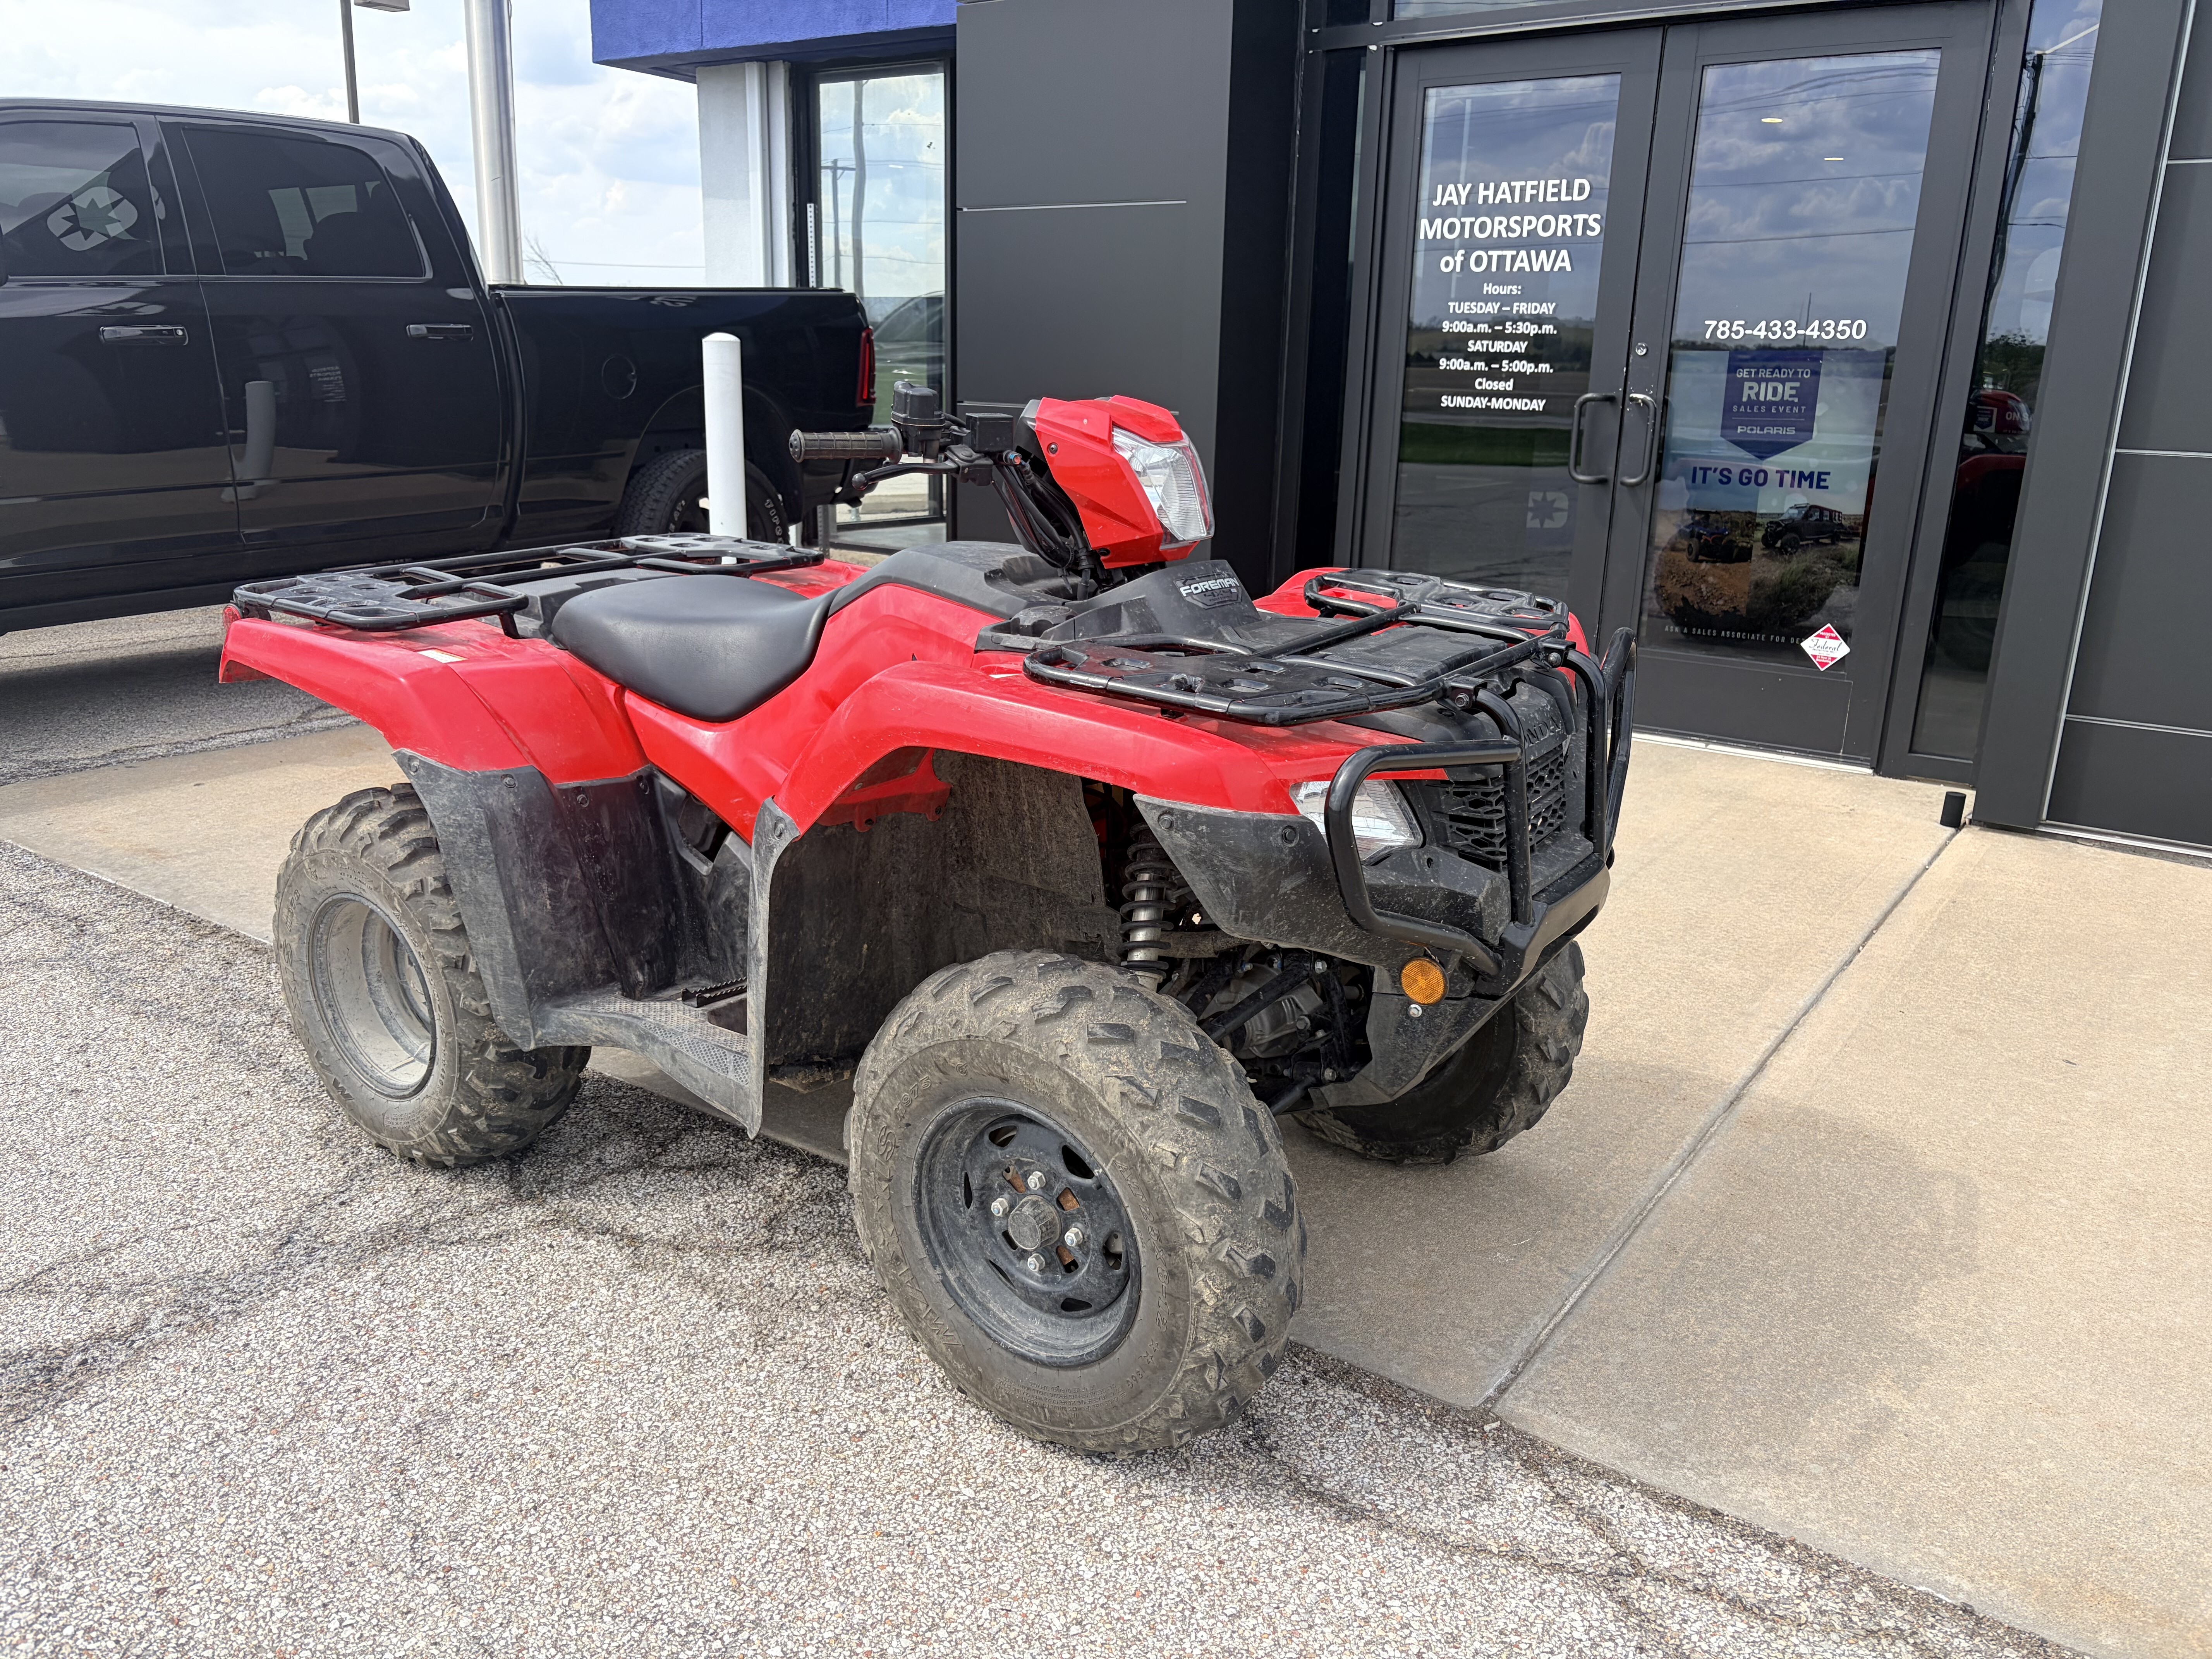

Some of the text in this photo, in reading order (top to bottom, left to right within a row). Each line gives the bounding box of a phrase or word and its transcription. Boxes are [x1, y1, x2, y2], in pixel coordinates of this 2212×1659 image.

[1432, 179, 1590, 206] JAY HATFIELD
[1419, 213, 1601, 240] MOTORSPORTS
[1440, 249, 1571, 273] of OTTAWA
[1483, 283, 1522, 295] Hours:
[1448, 302, 1501, 314] TUESDAY
[1513, 302, 1556, 314] FRIDAY
[1442, 320, 1492, 333] 9:00a.m.
[1504, 321, 1557, 337] 5:30p.m.
[1704, 319, 1867, 340] 785-433-4350
[1467, 340, 1528, 353] SATURDAY
[1439, 358, 1488, 371] 9:00a.m.
[1501, 360, 1553, 375] 5:00p.m.
[1736, 368, 1810, 378] GET READY TO
[1475, 378, 1514, 391] Closed
[1742, 381, 1800, 402] RIDE
[1441, 395, 1546, 411] SUNDAY-MONDAY
[1737, 426, 1796, 434] POLARIS
[1738, 468, 1768, 487] GO
[1776, 470, 1831, 489] TIME
[1180, 577, 1240, 597] FOREMAN
[1692, 628, 1716, 636] SALES
[1721, 630, 1765, 641] ASSOCIATE
[1808, 638, 1843, 651] Federal
[893, 1075, 931, 1121] M975
[873, 1124, 965, 1346] MAXXIS
[1113, 1160, 1170, 1332] AT25X8-12
